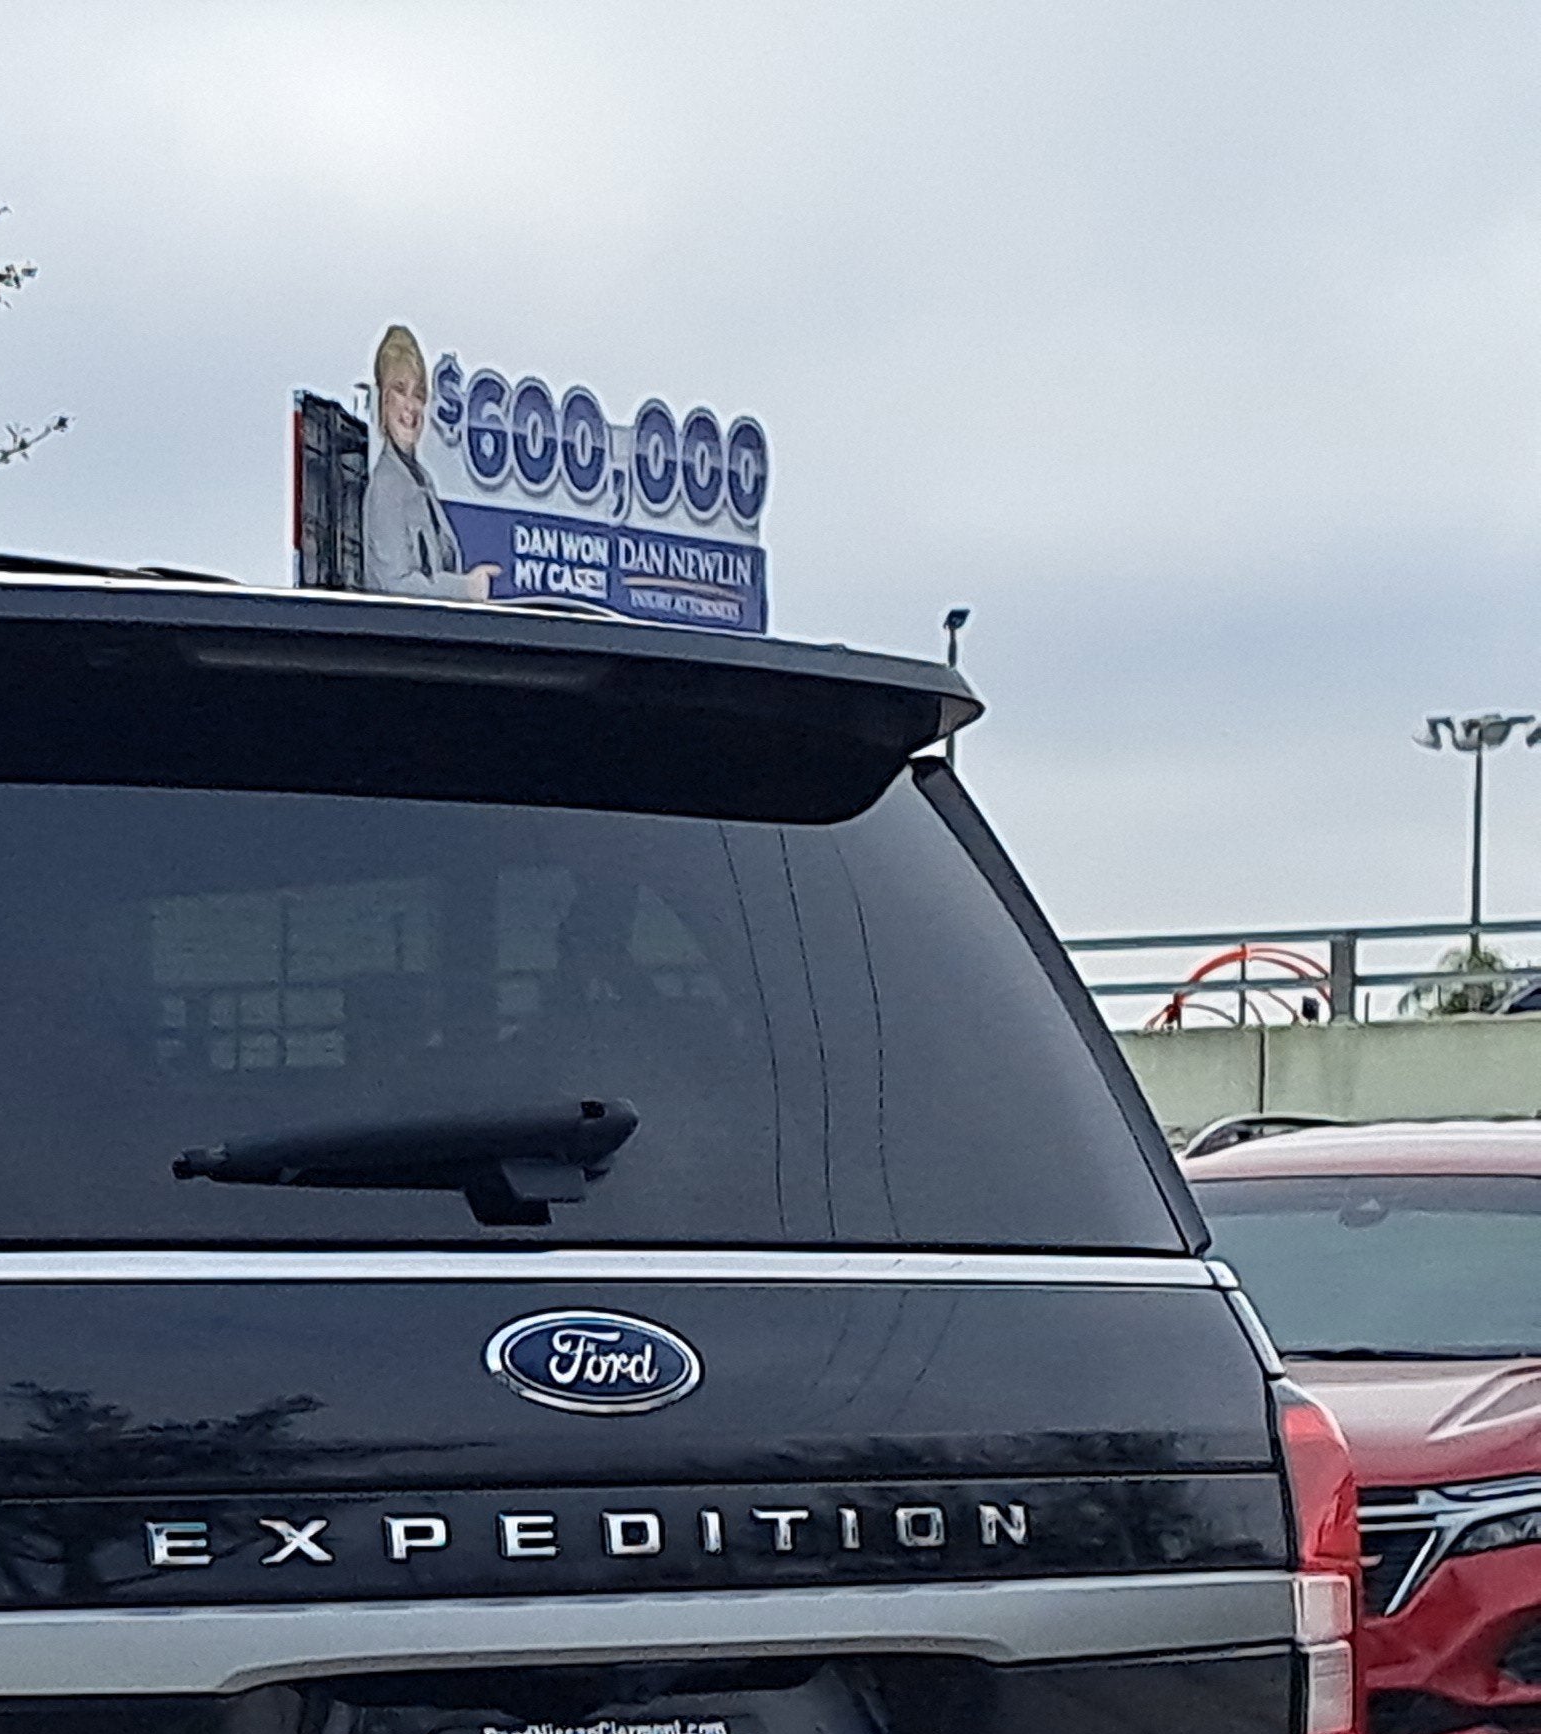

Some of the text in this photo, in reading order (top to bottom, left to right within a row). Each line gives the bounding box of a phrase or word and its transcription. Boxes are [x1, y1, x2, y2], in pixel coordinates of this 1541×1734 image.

[432, 351, 769, 521] $600,000
[516, 525, 609, 567] DAN WON
[619, 536, 753, 587] DAN NEWLIN
[515, 557, 547, 592] MY
[546, 1326, 658, 1386] Ford
[144, 1502, 1030, 1569] EXPEDITION
